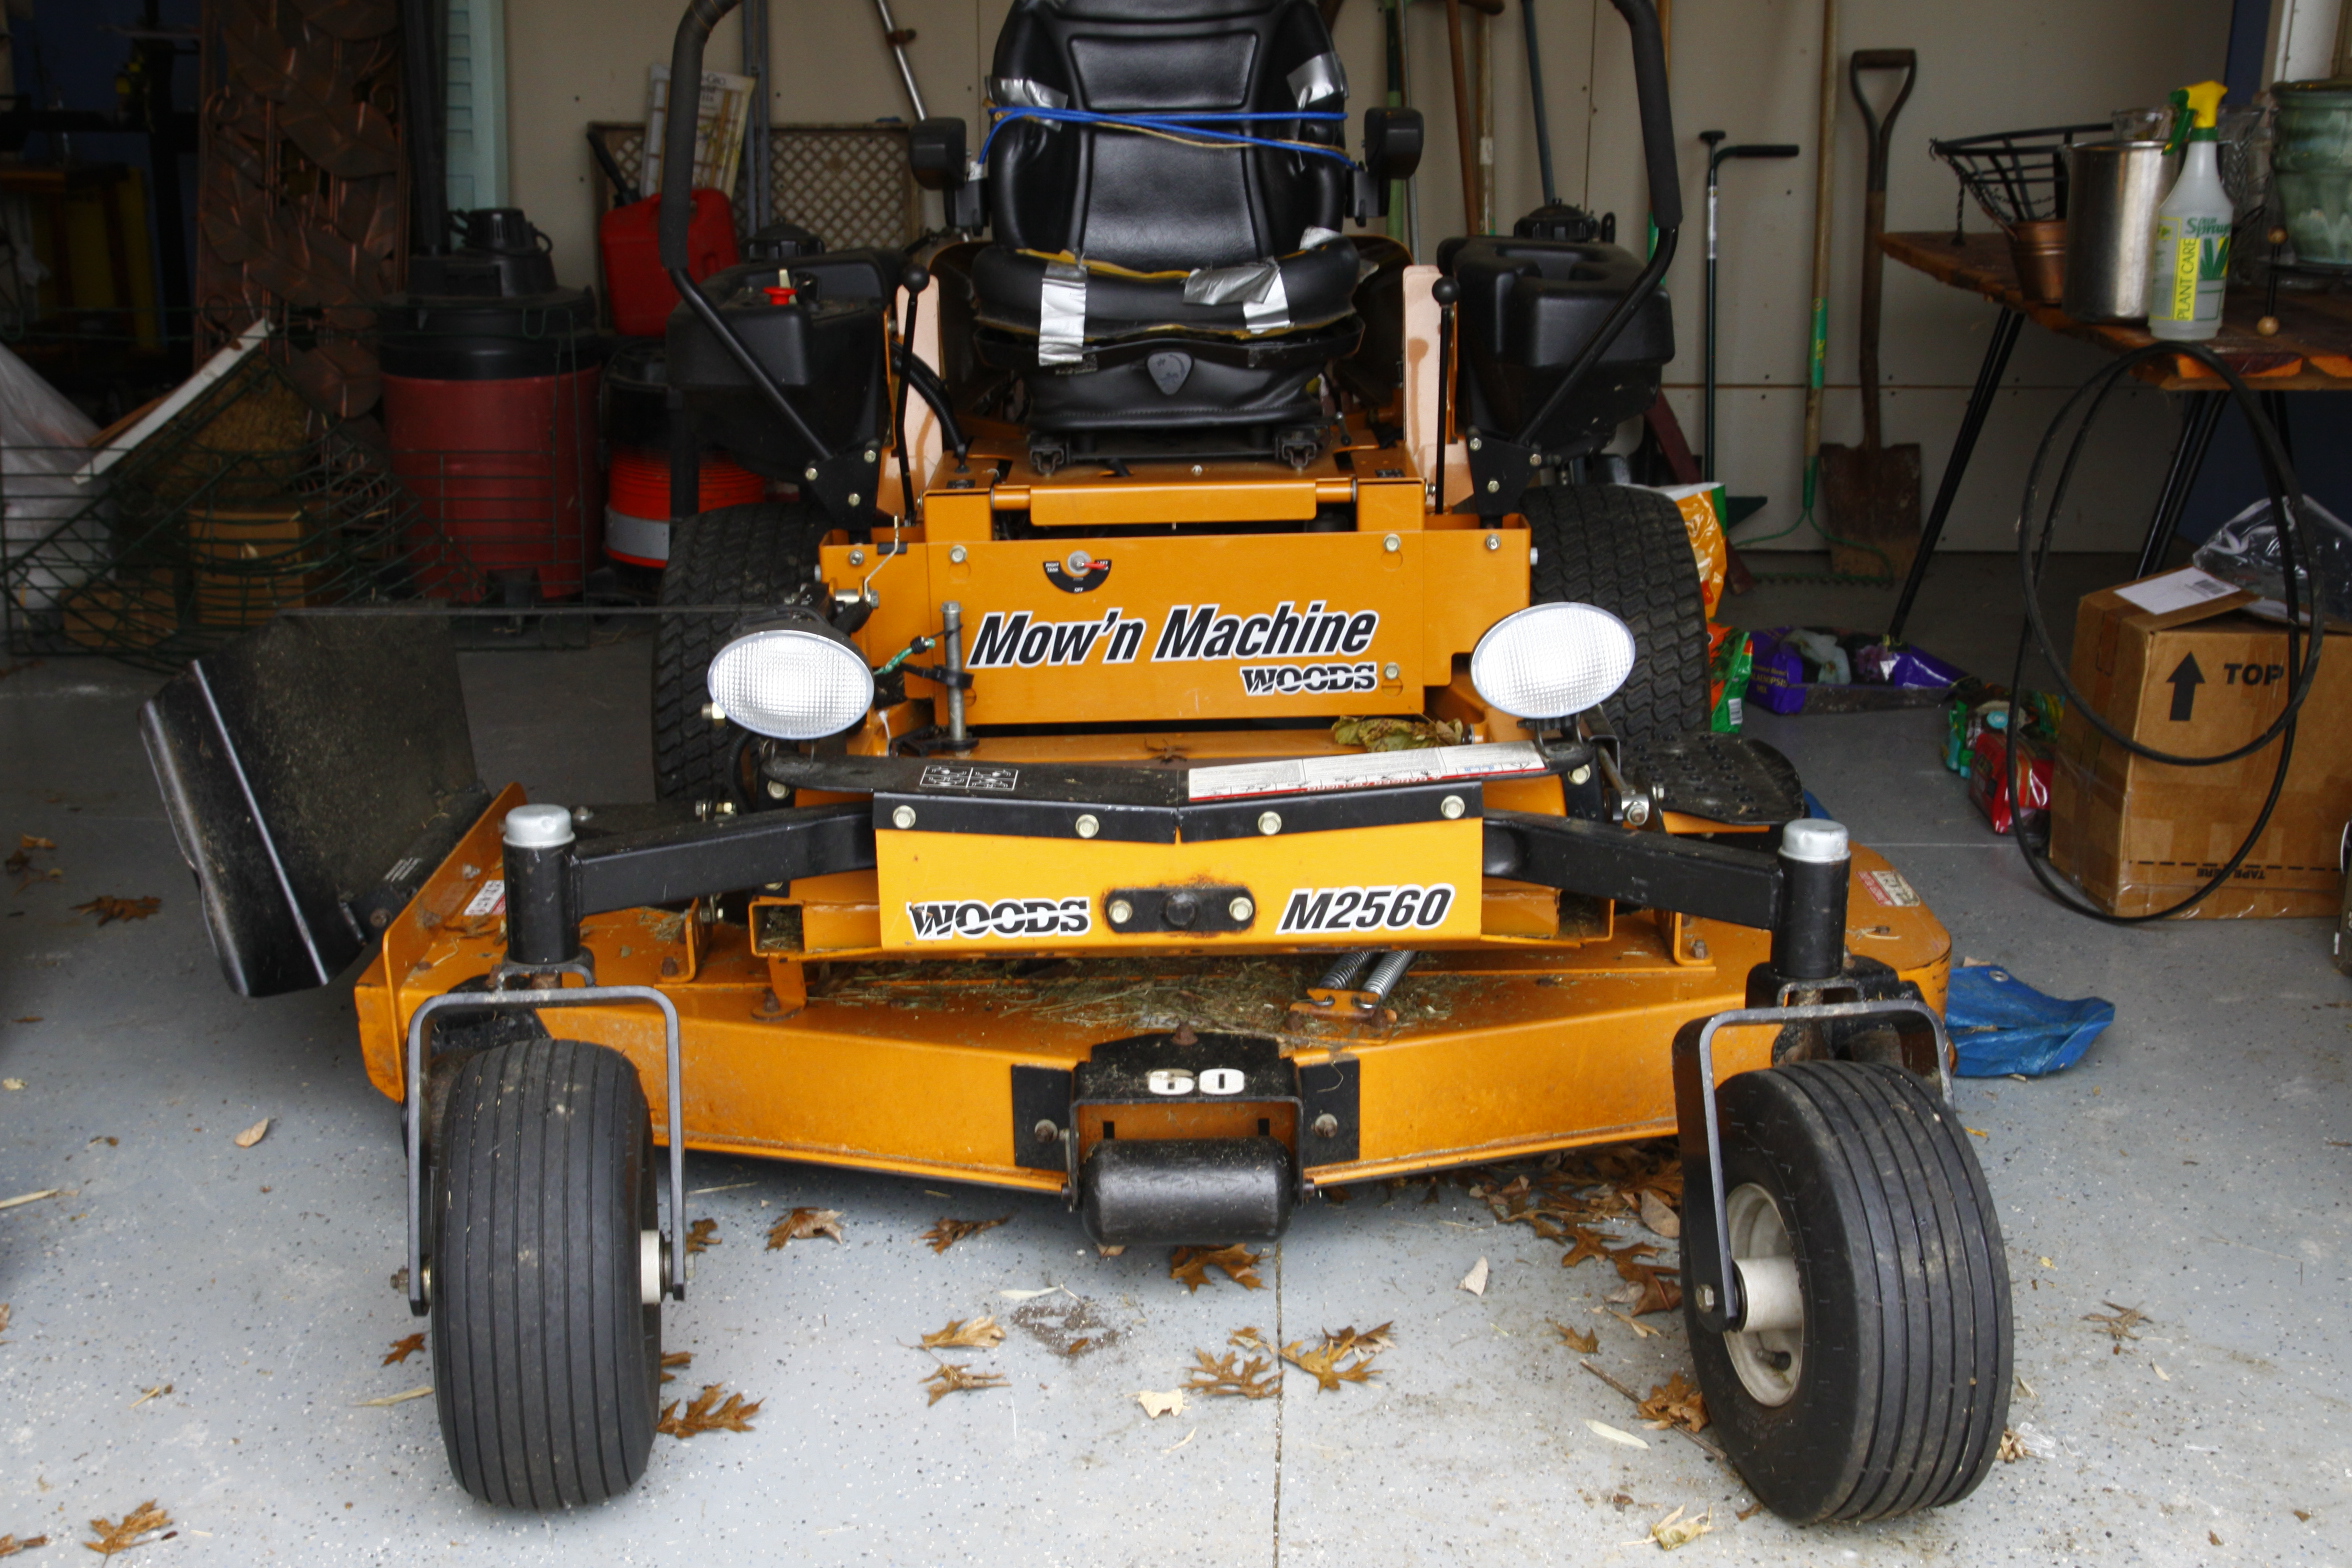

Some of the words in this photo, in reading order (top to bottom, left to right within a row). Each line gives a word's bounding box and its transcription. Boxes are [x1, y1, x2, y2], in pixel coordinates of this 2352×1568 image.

[2181, 239, 2197, 274] CARE
[2177, 278, 2194, 320] PLANT
[968, 608, 1145, 668] Mow'n
[1156, 600, 1378, 661] Machine
[1241, 663, 1377, 696] WOODS
[2224, 663, 2285, 686] TOP
[2234, 869, 2265, 880] TAPE
[907, 896, 1090, 940] WOODS
[1276, 883, 1455, 935] M2560
[1148, 1068, 1245, 1096] 60
